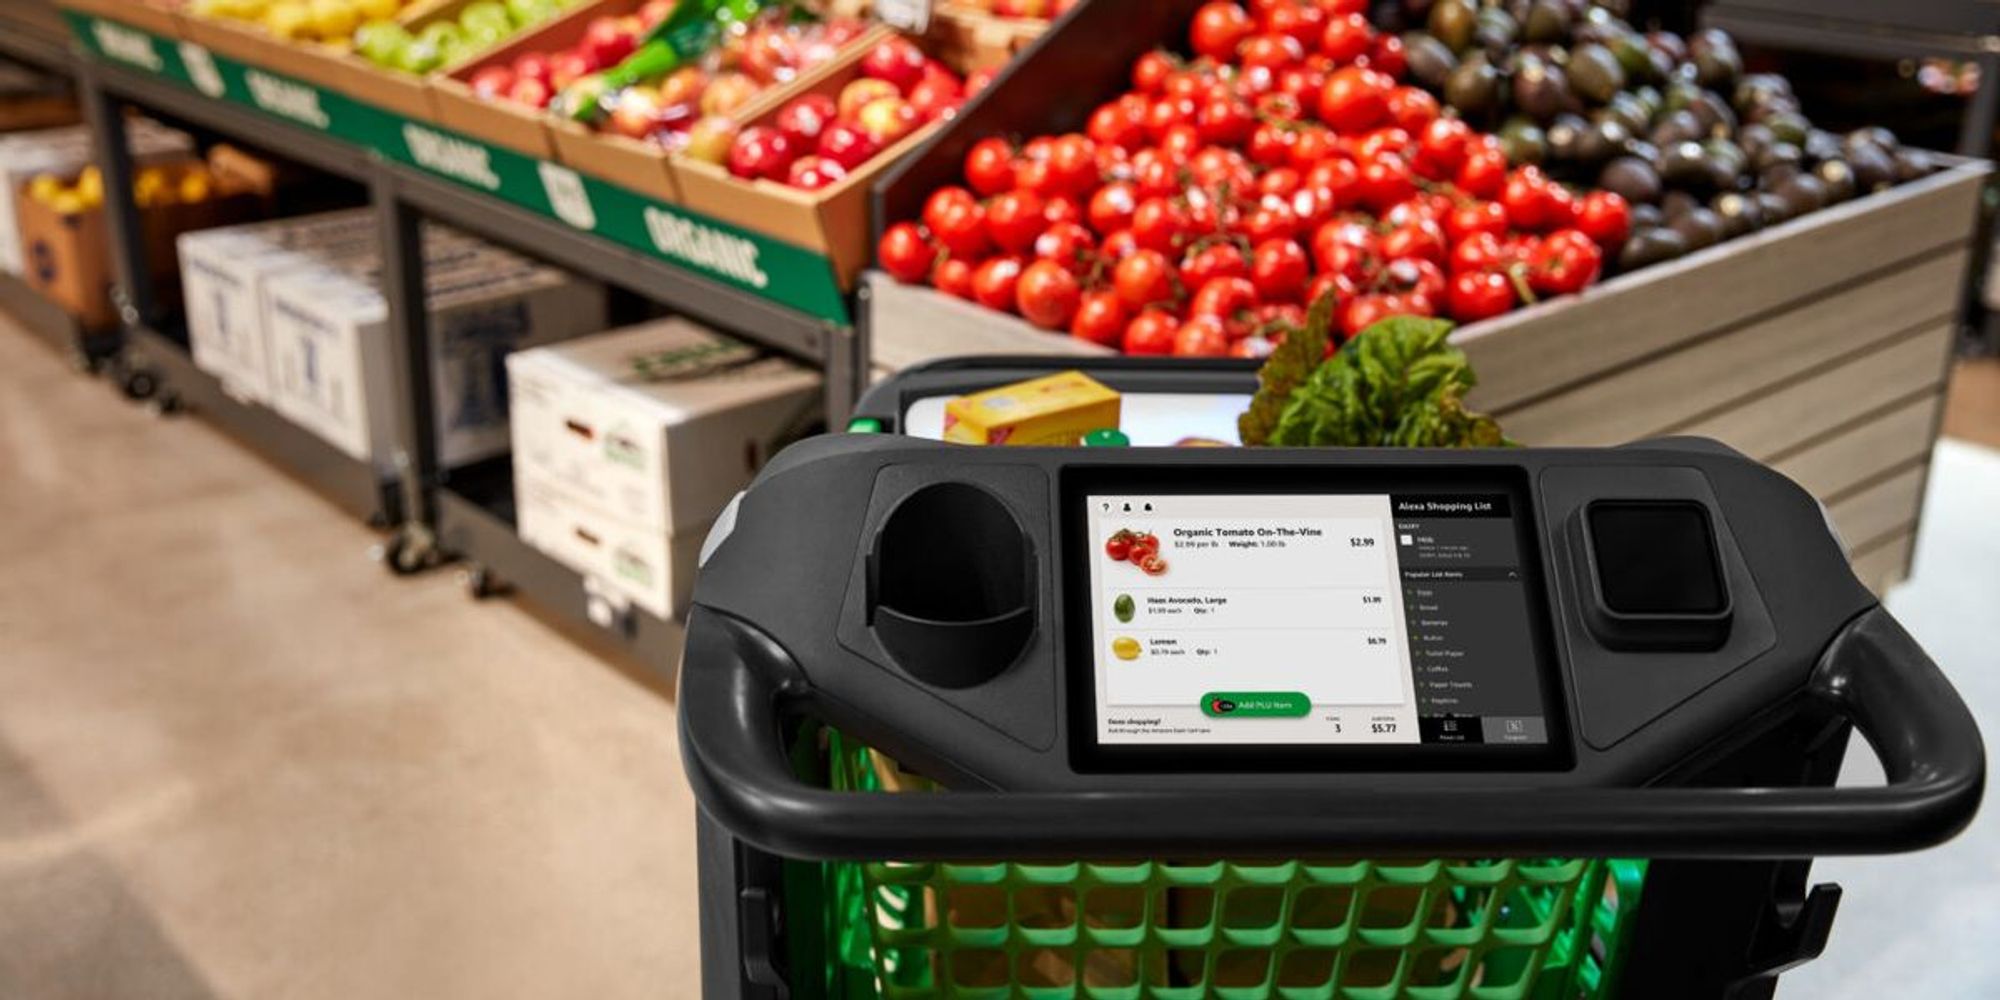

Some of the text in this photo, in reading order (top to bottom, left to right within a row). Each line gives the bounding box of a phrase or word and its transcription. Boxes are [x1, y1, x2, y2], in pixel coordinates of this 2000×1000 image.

[643, 204, 769, 289] ORGANIC
[1399, 502, 1492, 512] Alexa Shopping List
[1173, 527, 1322, 539] Organic Tomato On-The-Vine
[1350, 538, 1375, 547] $2.99
[1205, 597, 1227, 605] Large
[1238, 700, 1254, 709] Add
[1273, 700, 1293, 709] Item
[1335, 723, 1341, 733] 3
[1371, 723, 1397, 733] $5.77
